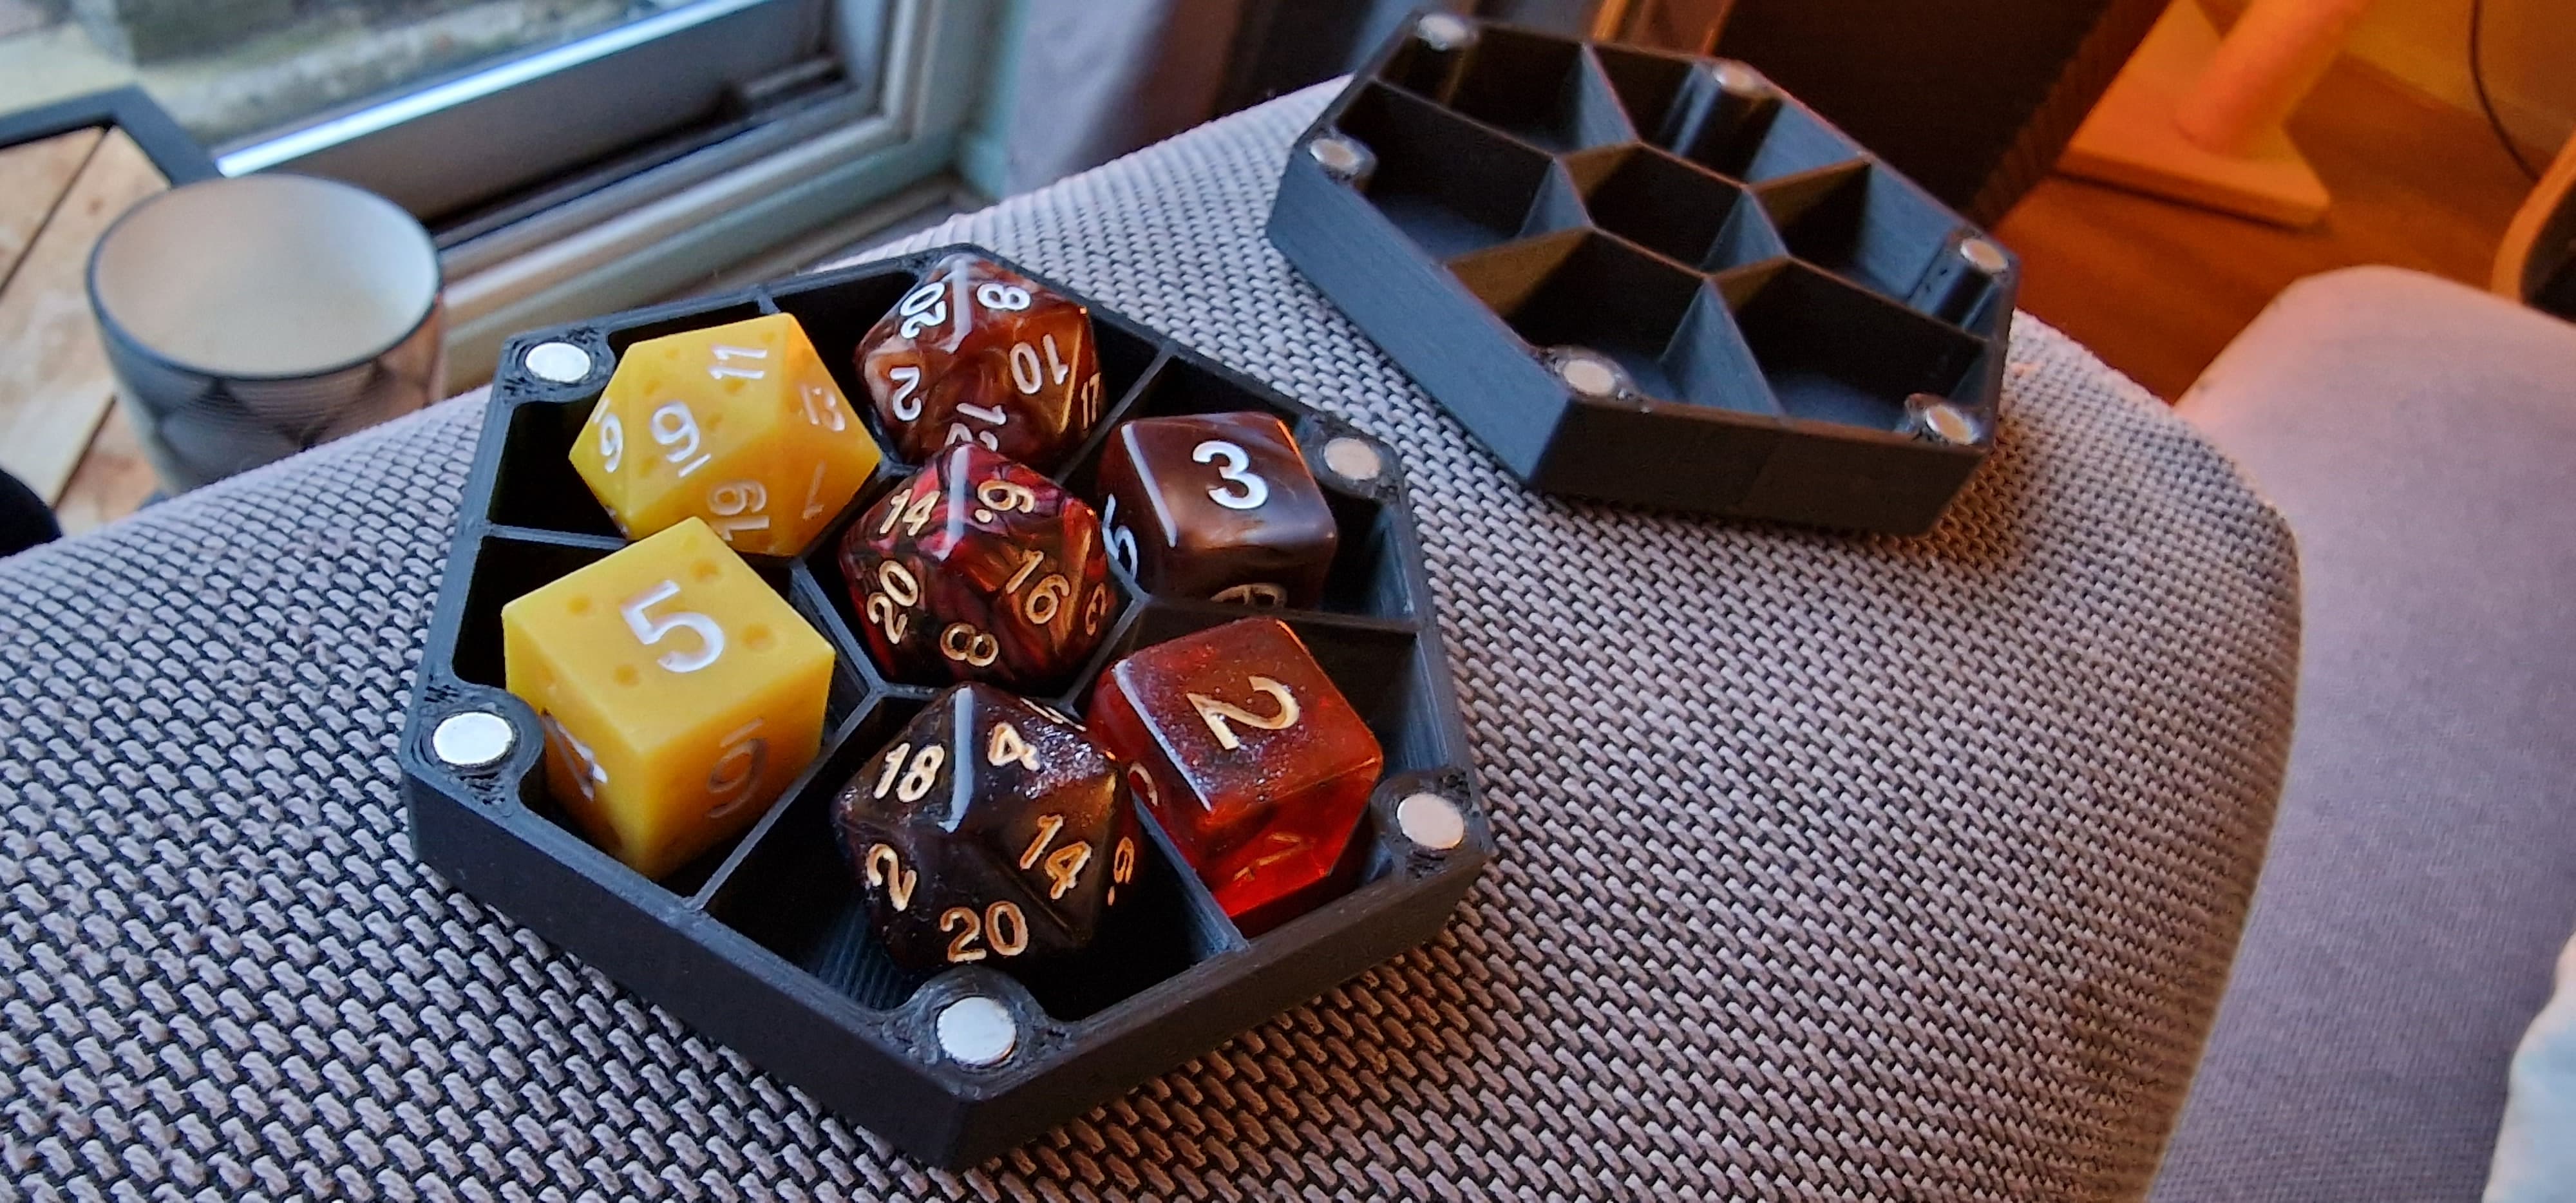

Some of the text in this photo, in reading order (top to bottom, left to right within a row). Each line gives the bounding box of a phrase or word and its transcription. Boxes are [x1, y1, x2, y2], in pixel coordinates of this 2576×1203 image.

[900, 281, 947, 339] 20
[976, 282, 1032, 310] 8
[709, 343, 768, 381] 11
[1009, 334, 1069, 394] 10
[889, 366, 922, 421] 2
[1191, 440, 1270, 509] 3
[708, 479, 771, 542] 19
[880, 488, 941, 536] 14
[866, 559, 920, 645] 20
[1005, 549, 1070, 625] 16
[620, 580, 725, 673] 5
[940, 622, 999, 667] 8
[1186, 675, 1300, 750] 2
[873, 743, 945, 803] 18
[987, 721, 1040, 772] 4
[866, 842, 917, 912] 2
[1019, 813, 1092, 900] 14
[940, 900, 1028, 963] 20
